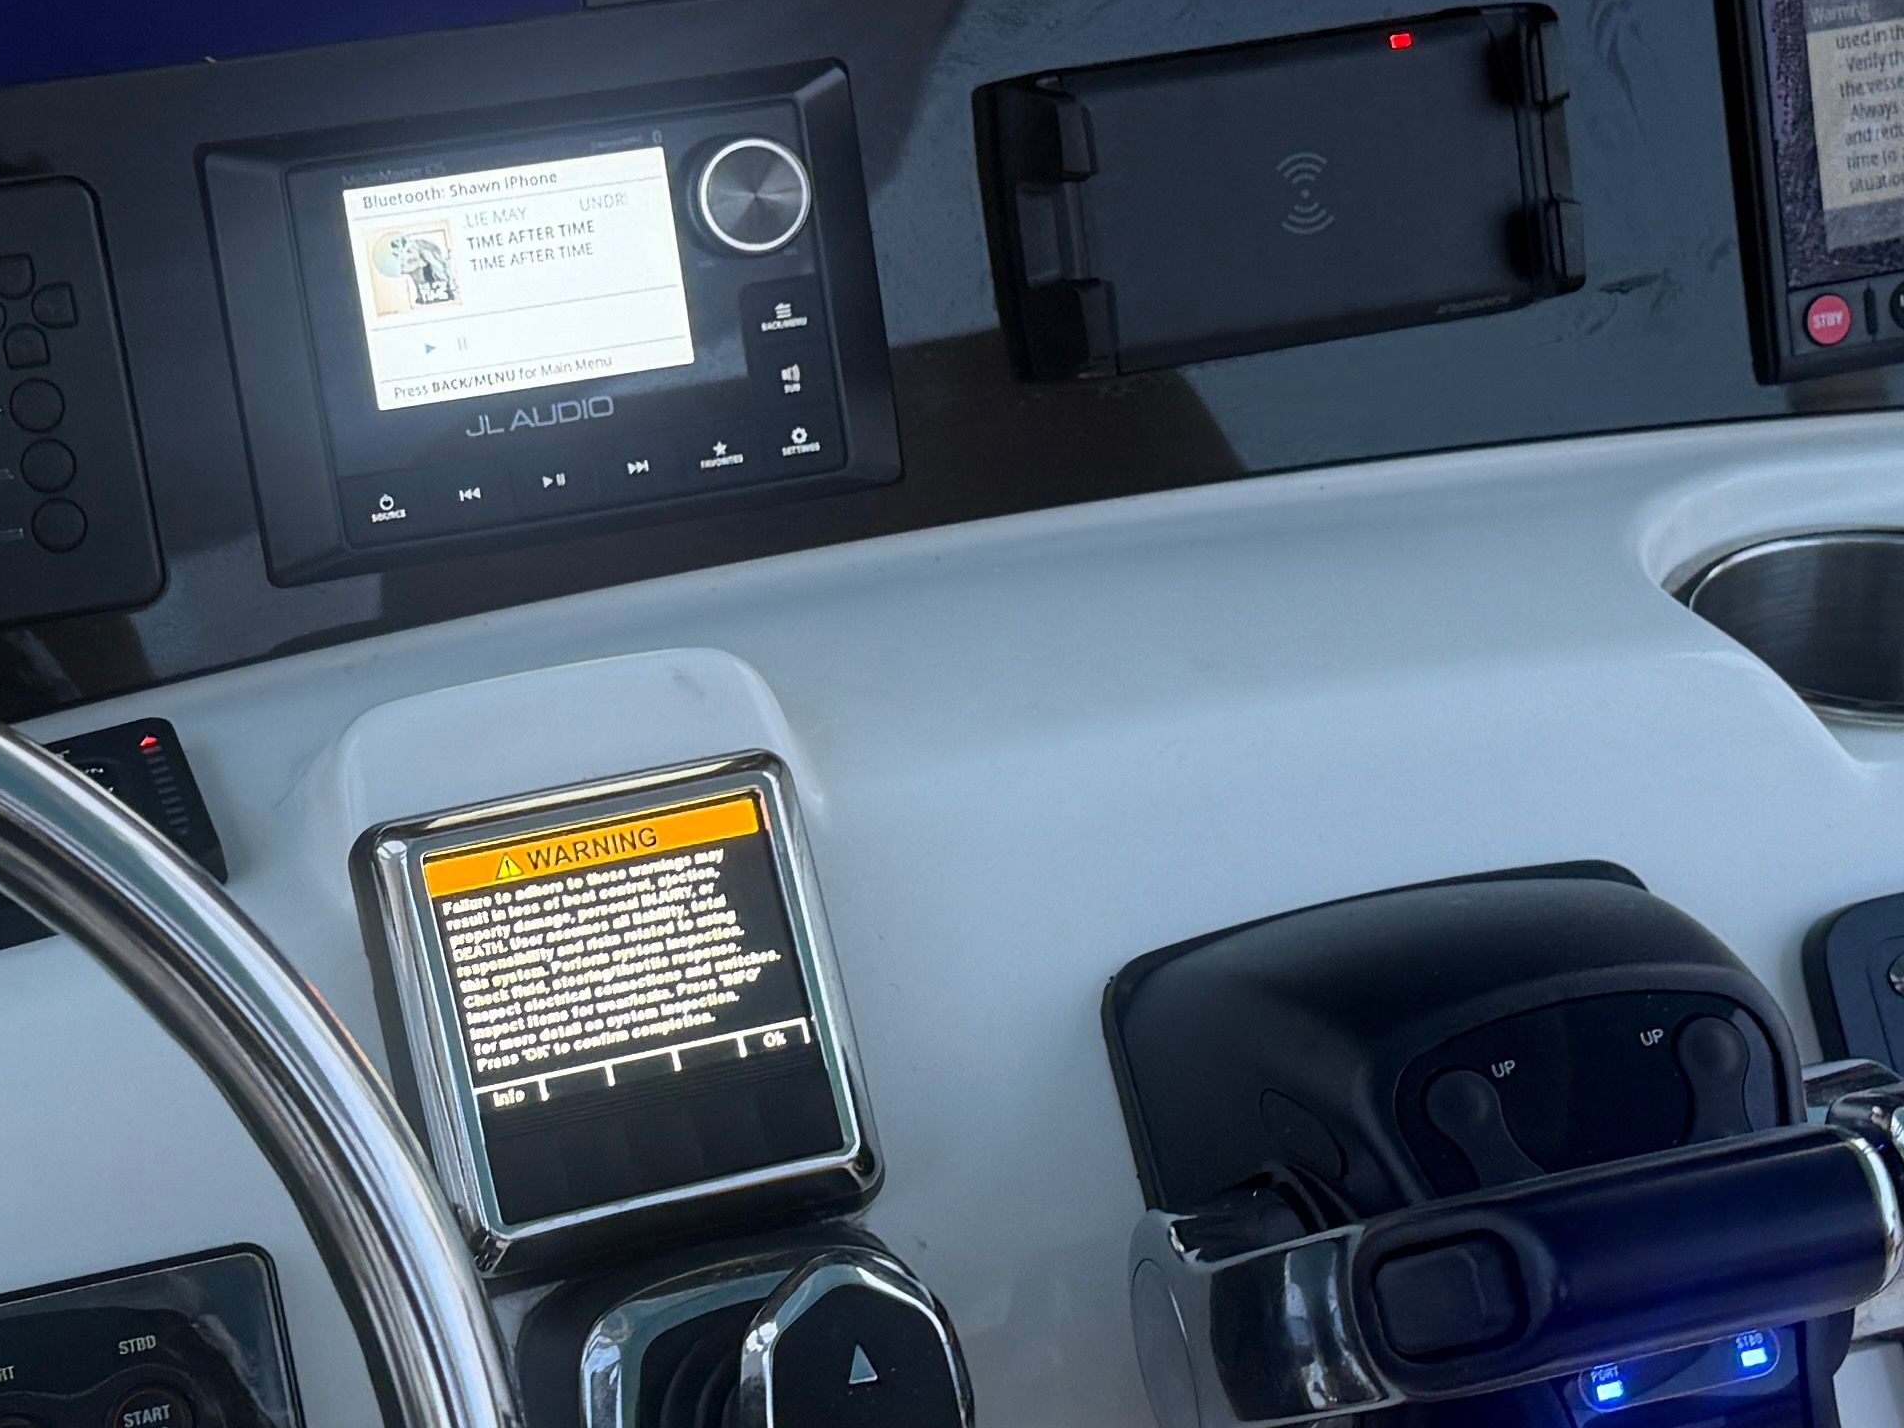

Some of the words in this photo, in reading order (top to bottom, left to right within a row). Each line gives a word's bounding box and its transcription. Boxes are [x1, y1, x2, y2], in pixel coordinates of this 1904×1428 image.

[362, 186, 445, 209] Bluetooth:
[449, 178, 500, 197] Shawn
[467, 233, 502, 249] TIME
[507, 225, 553, 244] AFTER
[558, 220, 594, 236] TIME
[471, 255, 504, 271] TIME
[509, 248, 555, 265] AFTER
[558, 243, 592, 258] TIME
[394, 383, 427, 399] Press
[432, 370, 515, 393] BACK/MENU
[519, 367, 536, 379] for
[541, 361, 572, 375] Main
[575, 355, 611, 370] Menu
[465, 412, 504, 439] JL
[509, 394, 614, 430] AUDIO
[527, 826, 657, 870] WARNING
[442, 894, 492, 915] Failure
[586, 868, 626, 886] these
[629, 855, 691, 878] warnings
[694, 848, 724, 865] may
[446, 911, 488, 930] result
[460, 977, 489, 995] this
[491, 964, 549, 988] system.
[551, 952, 610, 976] Perform
[612, 941, 664, 963] system
[477, 1052, 518, 1073] Press
[573, 1028, 628, 1052] confirm
[762, 1030, 786, 1048] Ok
[1639, 1028, 1664, 1046] UP
[1491, 1060, 1515, 1078] UP
[492, 1086, 525, 1108] Info
[118, 1334, 157, 1356] STBD
[122, 1404, 171, 1428] START
